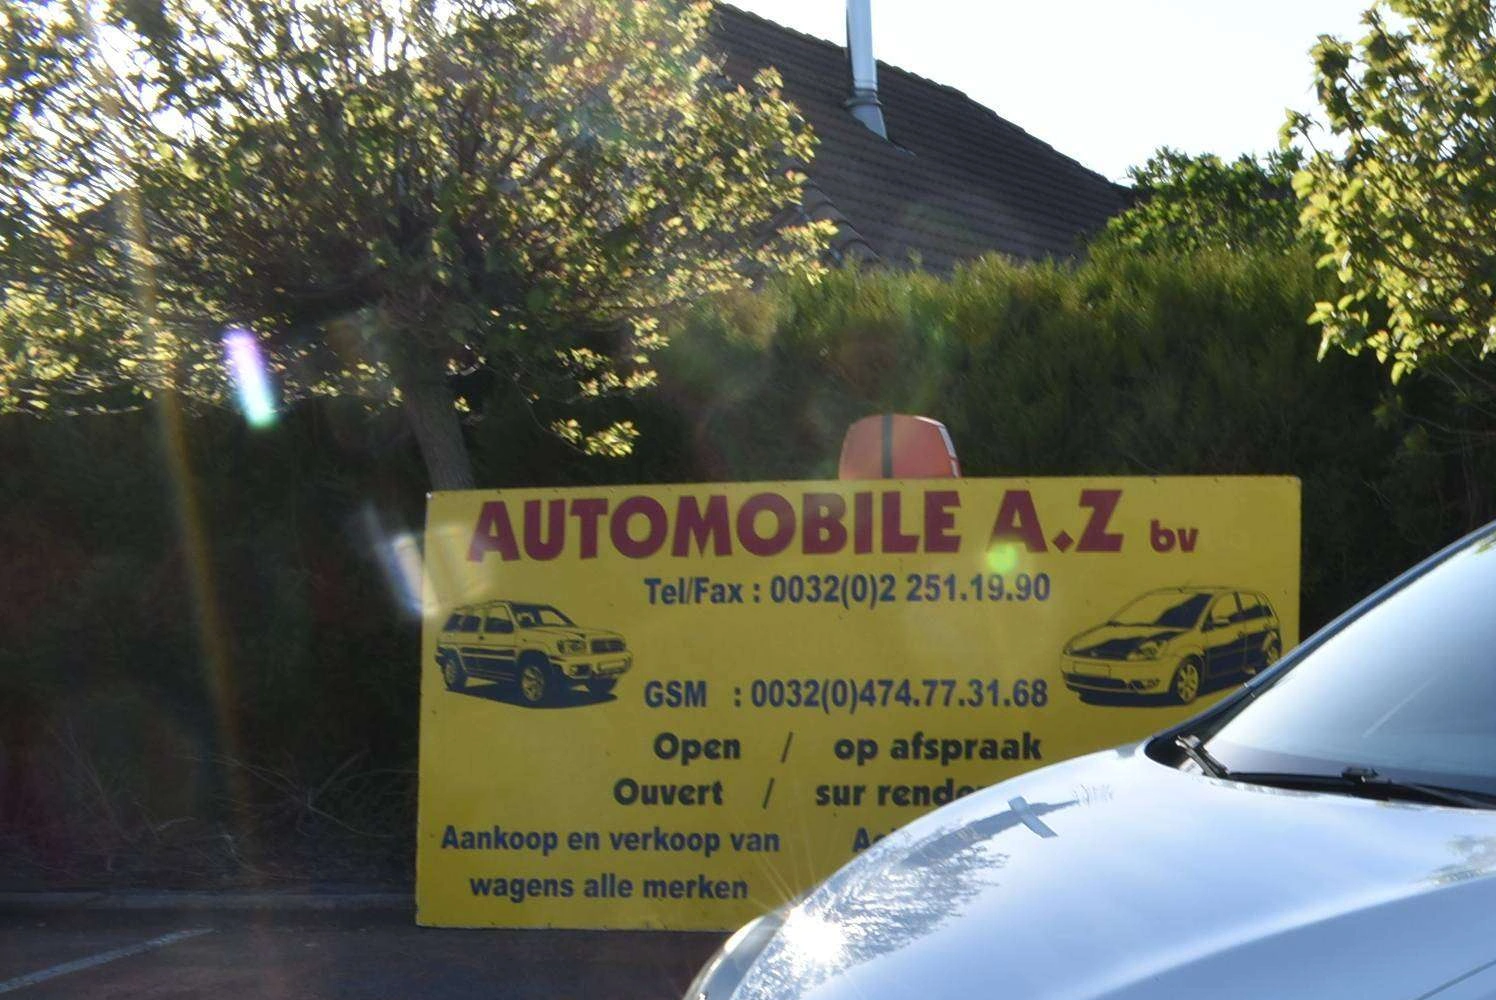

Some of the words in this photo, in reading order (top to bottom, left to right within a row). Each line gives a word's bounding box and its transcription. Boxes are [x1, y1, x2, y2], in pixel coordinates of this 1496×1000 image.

[467, 491, 961, 561] AUTOMOBILE
[987, 489, 1123, 553] A.Z
[1150, 519, 1198, 552] bv
[644, 577, 744, 605] Tel/Fax
[770, 574, 896, 610] 0032(0)2
[907, 573, 1051, 602] 251.19.90
[645, 681, 706, 708] GSM
[752, 679, 1048, 714] 0032(0)474.77.31.68
[654, 732, 740, 766] Open
[834, 738, 878, 766] op
[890, 731, 1042, 766] afspraak
[613, 778, 723, 806] Ouvert
[816, 784, 866, 806] sur
[878, 778, 990, 807] rend
[442, 824, 558, 856] Aankoop
[568, 832, 600, 851] en
[610, 827, 721, 857] verkoop
[731, 832, 780, 853] van
[470, 876, 574, 903] wagens
[583, 874, 634, 899] alle
[643, 874, 748, 900] merken
